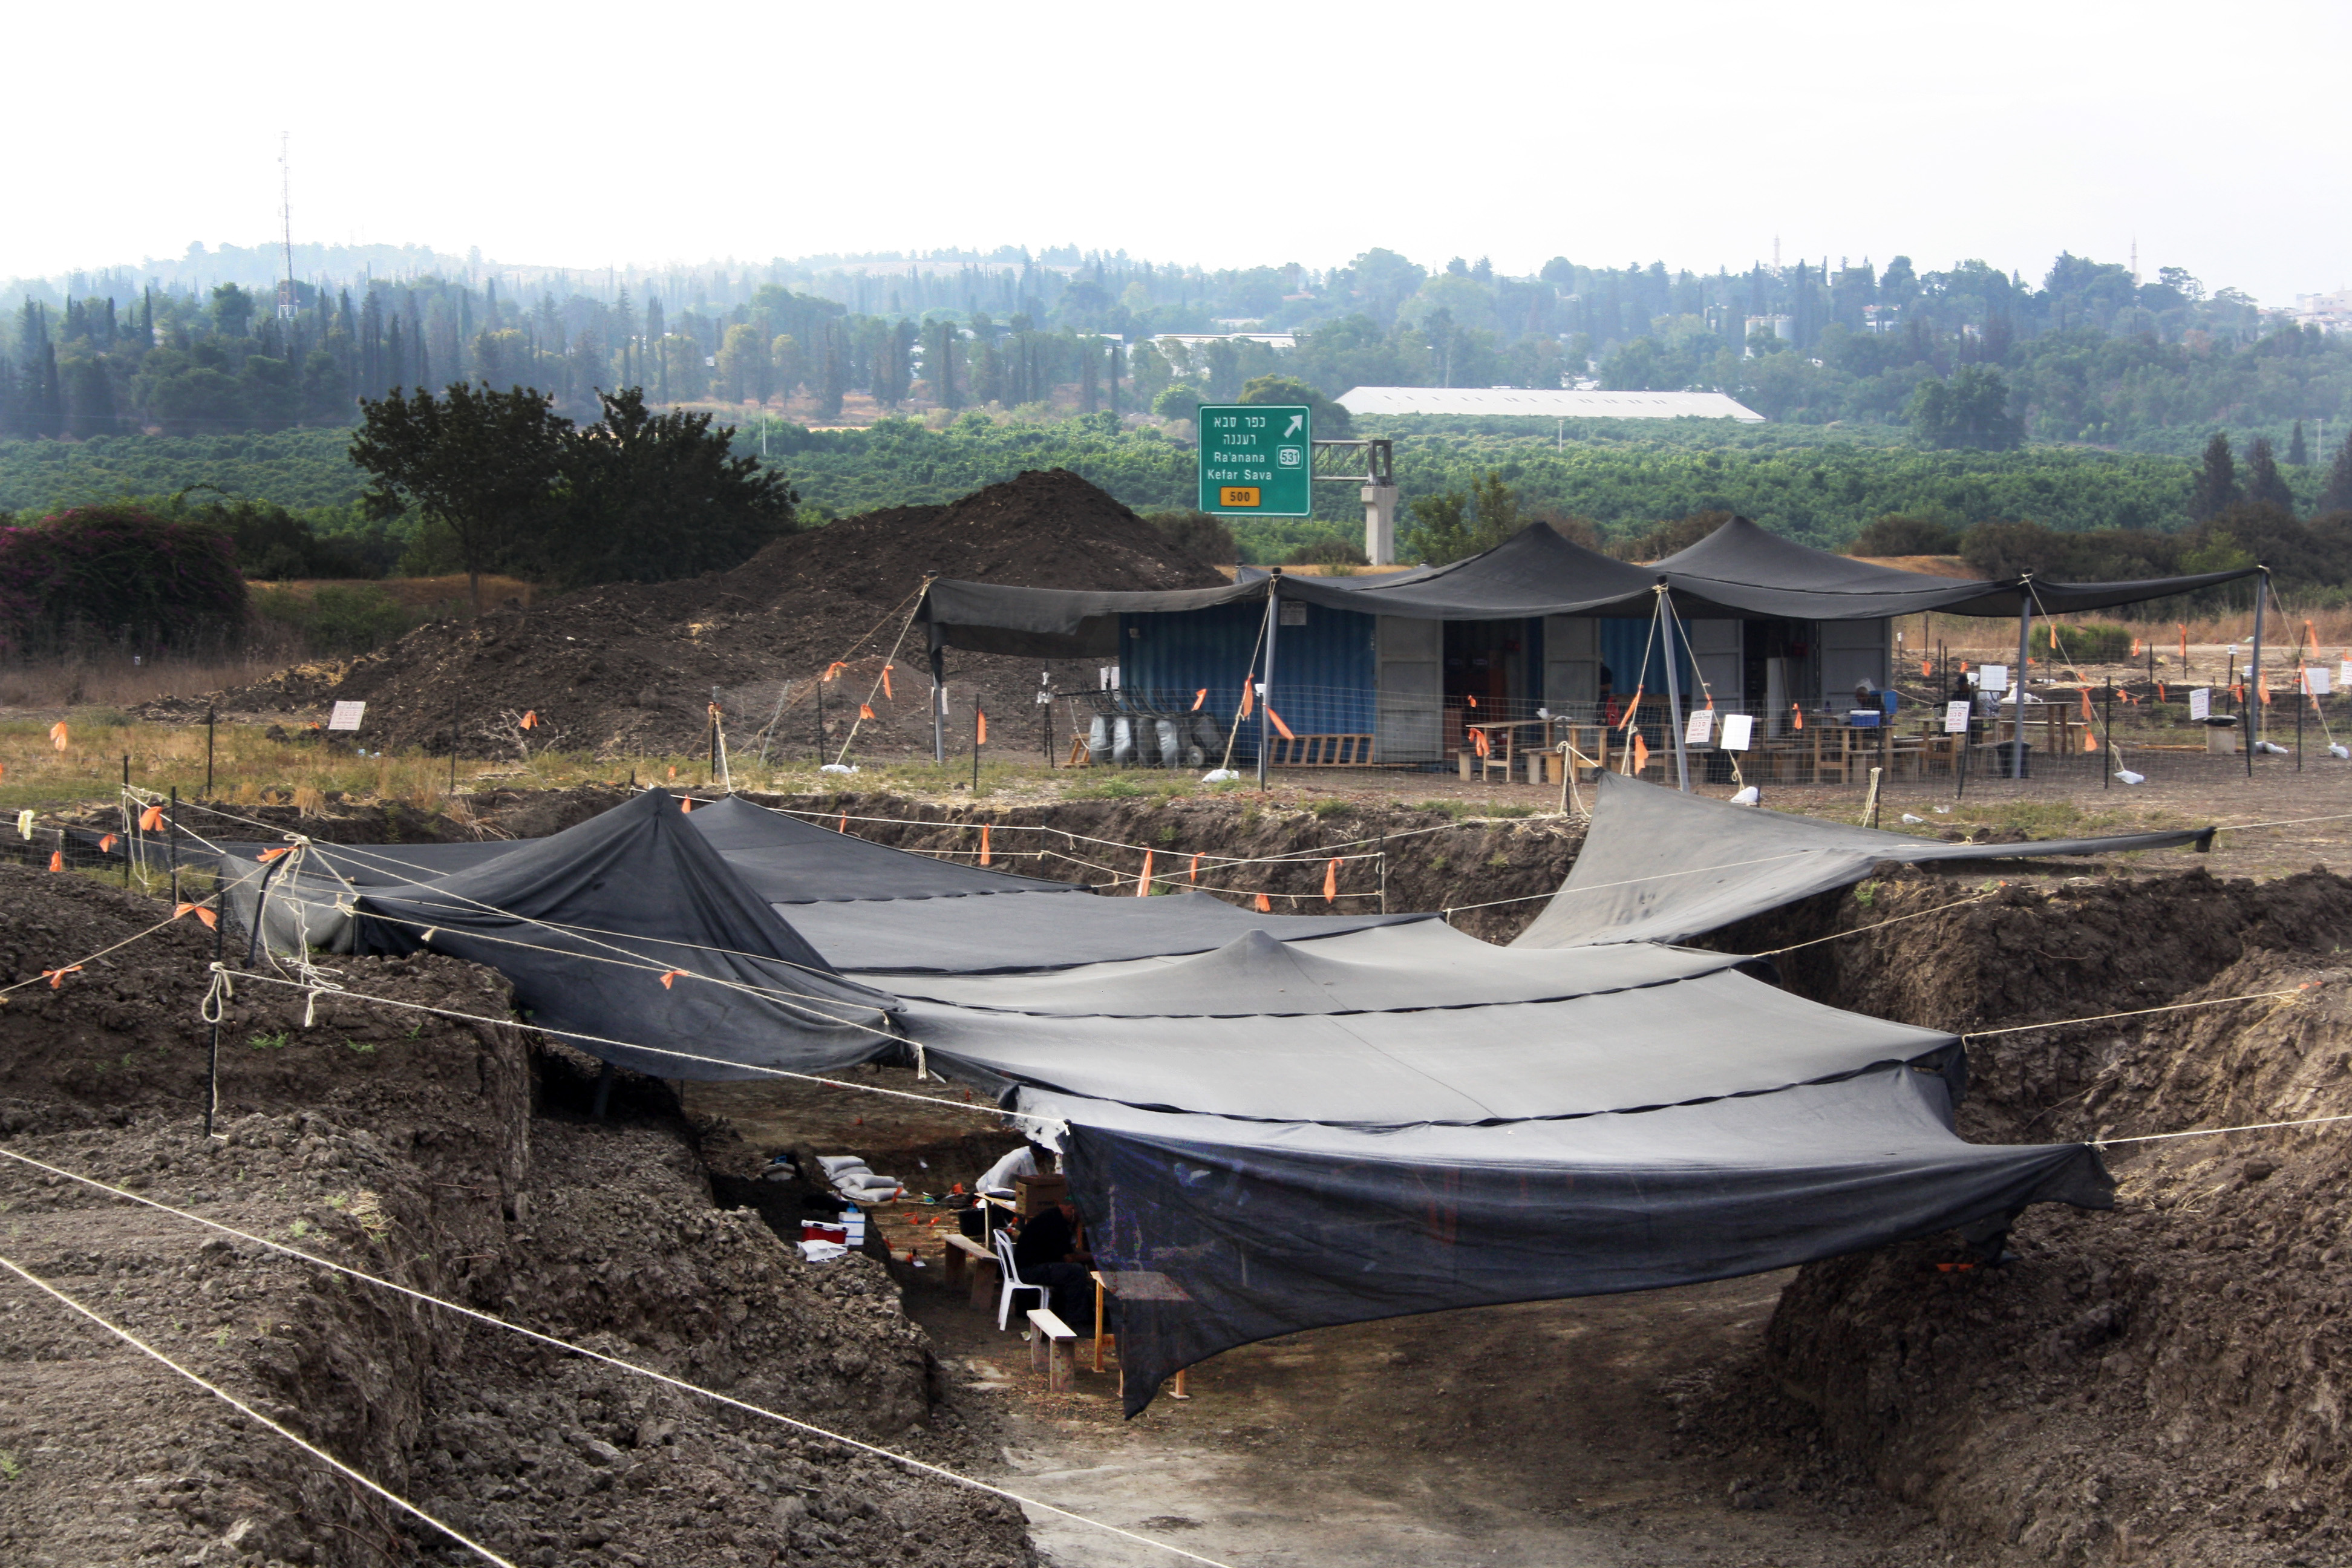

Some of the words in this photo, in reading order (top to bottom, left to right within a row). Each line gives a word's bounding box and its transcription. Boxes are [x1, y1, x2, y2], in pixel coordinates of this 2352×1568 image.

[1214, 417, 1236, 428] סבא
[1246, 417, 1266, 428] כפר
[1223, 434, 1256, 445] רעננה
[1214, 452, 1265, 462] Ra'anana
[1281, 452, 1299, 462] 531
[1207, 469, 1238, 480] Kefar
[1244, 469, 1272, 480] Sava
[1230, 491, 1250, 501] 500
